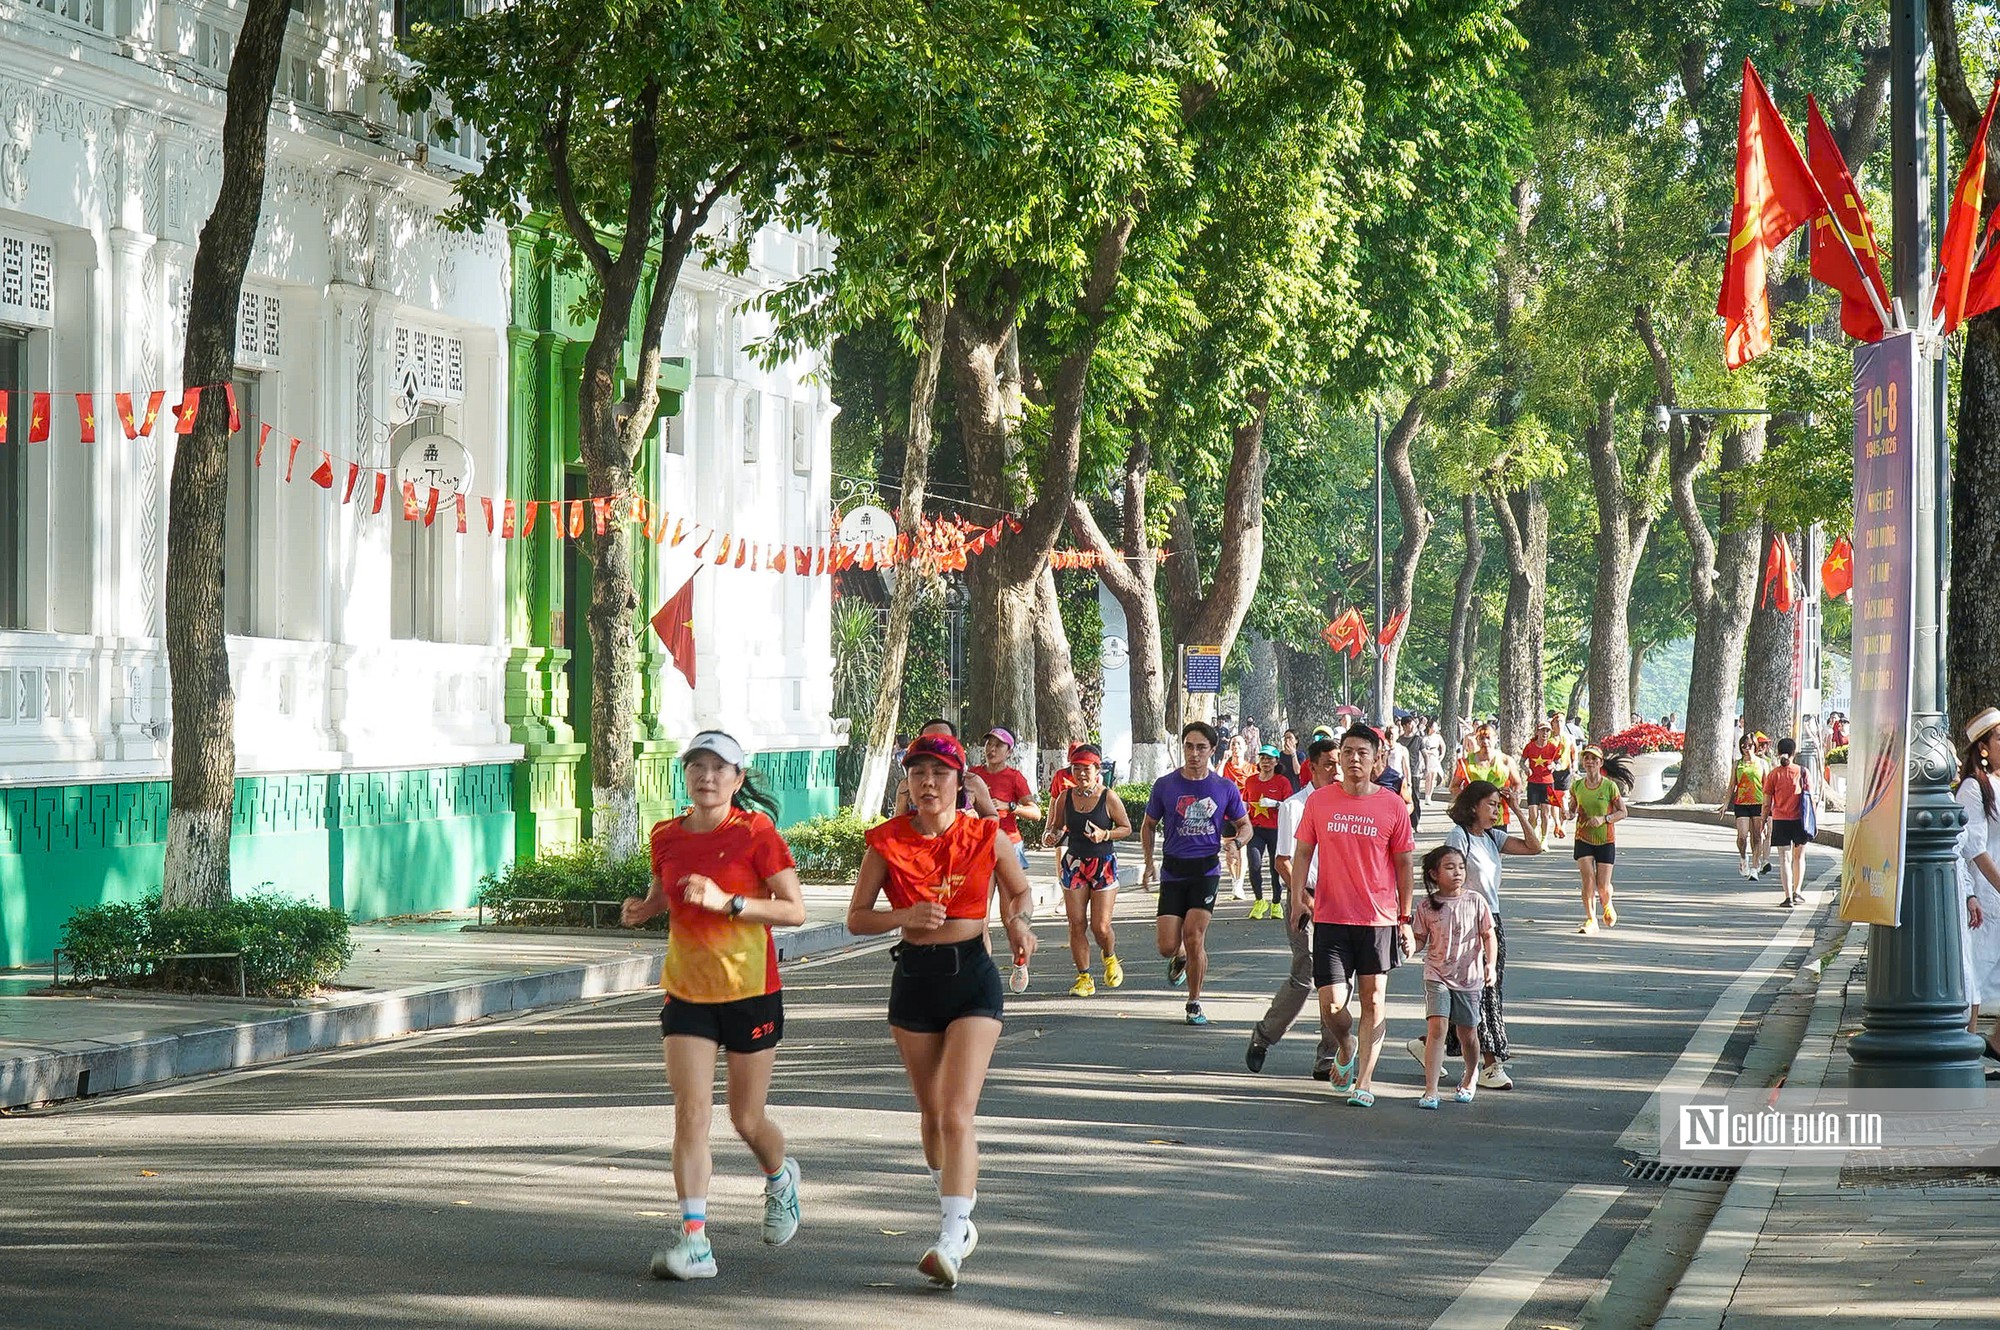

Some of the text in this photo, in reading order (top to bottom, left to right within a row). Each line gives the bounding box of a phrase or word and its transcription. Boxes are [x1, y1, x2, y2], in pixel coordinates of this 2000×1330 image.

[1866, 381, 1897, 437] 19-8
[1333, 813, 1374, 823] GARMIN
[1327, 822, 1377, 836] RUN CLUB
